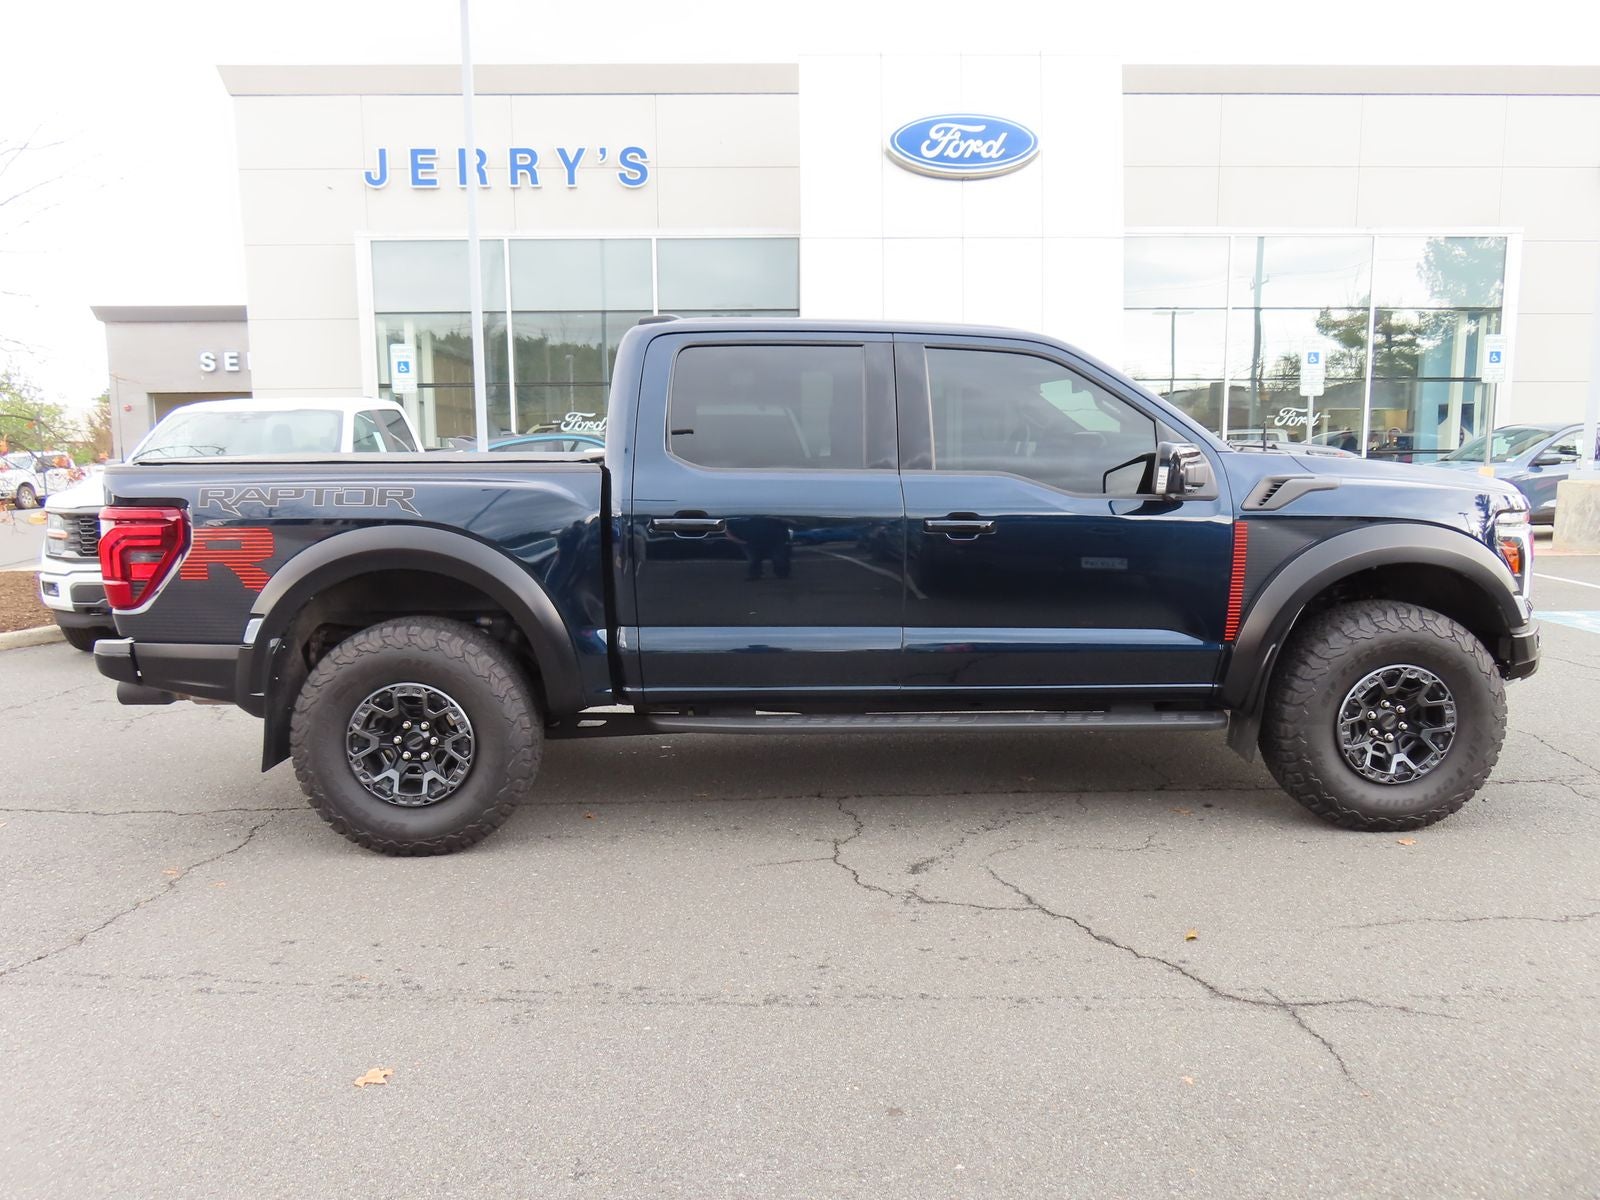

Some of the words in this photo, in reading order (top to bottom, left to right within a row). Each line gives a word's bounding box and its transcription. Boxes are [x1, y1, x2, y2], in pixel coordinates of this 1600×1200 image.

[920, 122, 1008, 159] Ford
[363, 146, 650, 187] JERRY'S
[200, 352, 251, 372] SE
[560, 411, 608, 431] Ford
[198, 486, 423, 518] RAPTOR
